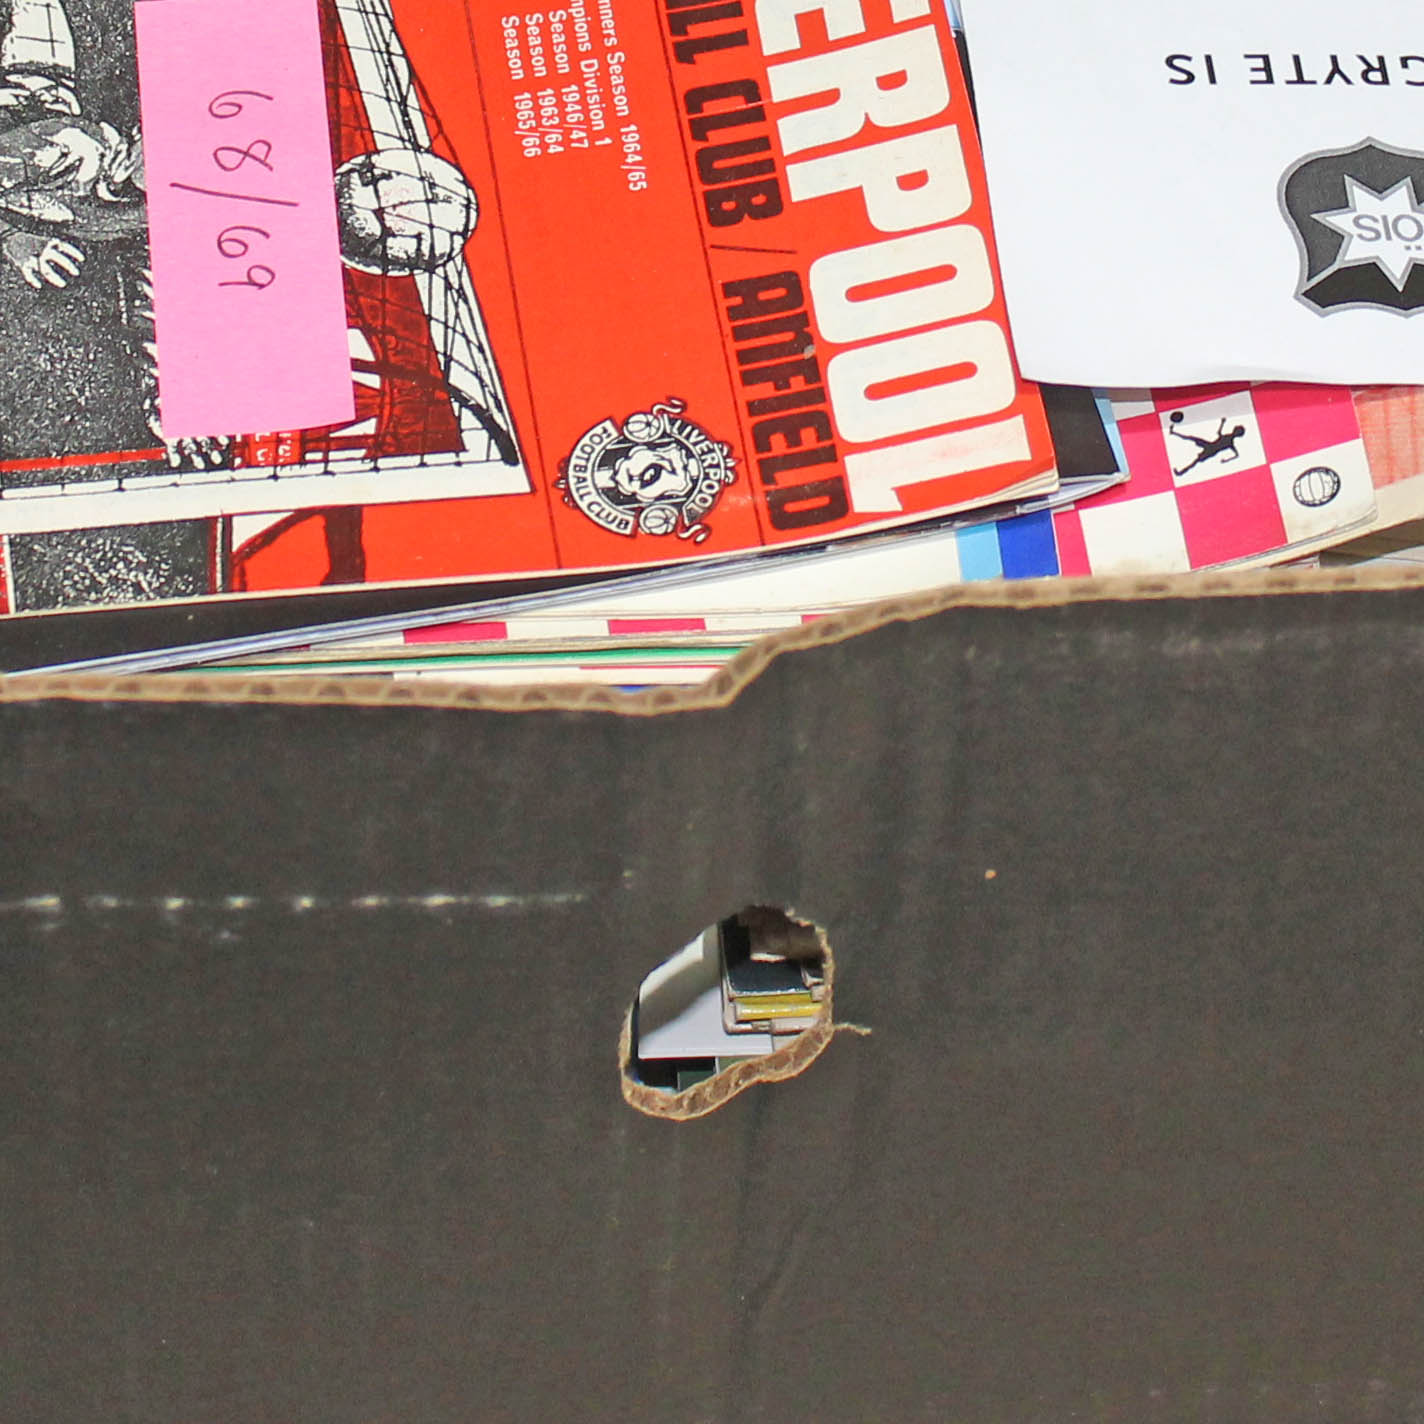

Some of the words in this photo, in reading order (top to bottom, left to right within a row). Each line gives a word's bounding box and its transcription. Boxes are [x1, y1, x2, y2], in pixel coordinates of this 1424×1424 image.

[501, 16, 525, 80] Season
[513, 92, 541, 158] 1965/66
[525, 13, 548, 77] Season
[537, 88, 564, 154] 1963/64
[548, 9, 571, 74] Season
[561, 84, 589, 148] 1946/47
[579, 59, 606, 131] Division
[594, 137, 613, 146] 1
[607, 51, 631, 117] Season
[619, 124, 647, 191] 1964/65
[1165, 54, 1217, 85] IS
[169, 89, 300, 291] 68/69
[682, 76, 786, 229] CLUB
[1352, 214, 1424, 251] ÖIS
[572, 426, 613, 501] FOOTBALL
[672, 419, 720, 514] LIVERPOOL
[721, 267, 852, 533] ANFIELD
[586, 501, 630, 531] CLUB
